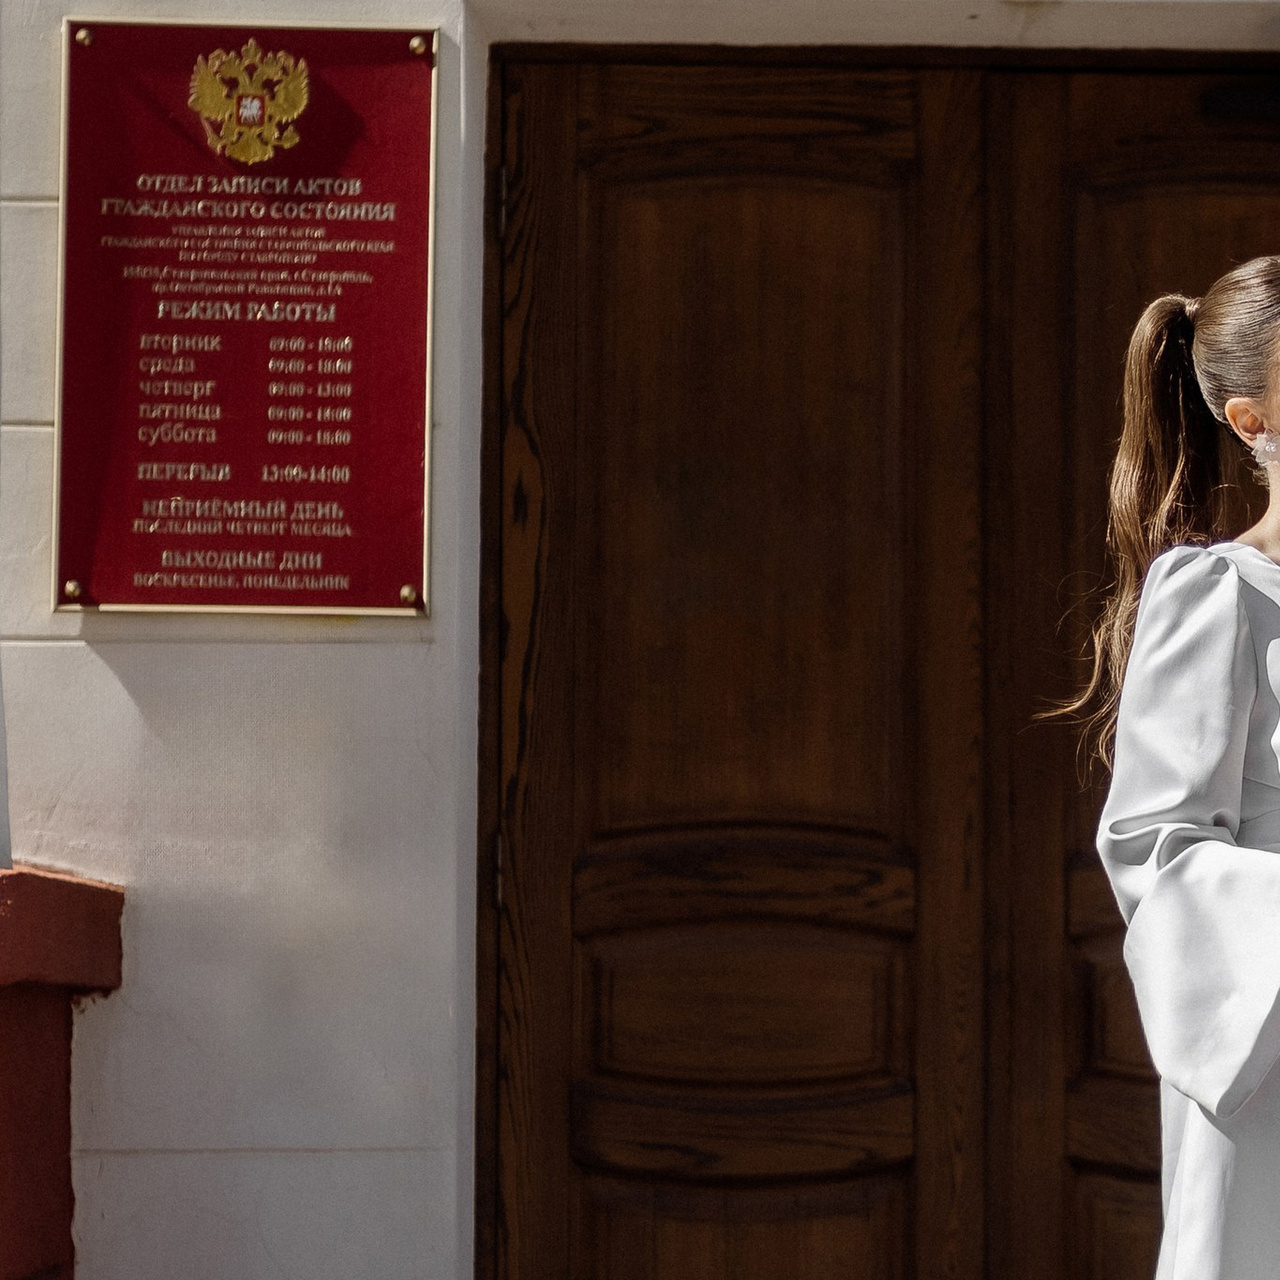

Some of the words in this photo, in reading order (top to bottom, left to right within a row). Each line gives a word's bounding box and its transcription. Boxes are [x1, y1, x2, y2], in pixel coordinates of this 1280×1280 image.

[136, 175, 203, 194] ОТДЕЛ
[207, 175, 288, 194] ЗАПИСИ
[293, 178, 363, 196] АКТОВ
[101, 198, 265, 219] ГРАЖДАНСКОГО
[270, 201, 395, 221] СОСТОЯНИЯ
[157, 301, 241, 321] РЕЖИМ
[247, 301, 336, 322] РАБОТЫ
[139, 334, 222, 355] вторник
[139, 357, 195, 376] среда
[139, 380, 216, 400] четверг
[139, 403, 222, 420] пятница
[138, 422, 217, 446] суббота
[137, 462, 231, 481] ПЕРЕРЫВ
[142, 497, 286, 518] НЕПРИЁМНЫЙ
[290, 501, 344, 520] ДЕНЬ
[133, 519, 222, 535] ПОСЛЕДНИЙ
[226, 520, 287, 536] ЧЕТВЕРГ
[291, 521, 352, 537] МЕСЯЦА
[162, 550, 275, 570] ВЫХОДНЫЕ
[279, 551, 322, 571] ДНИ
[243, 574, 349, 590] ПОНЕДЕЛЬНИК
